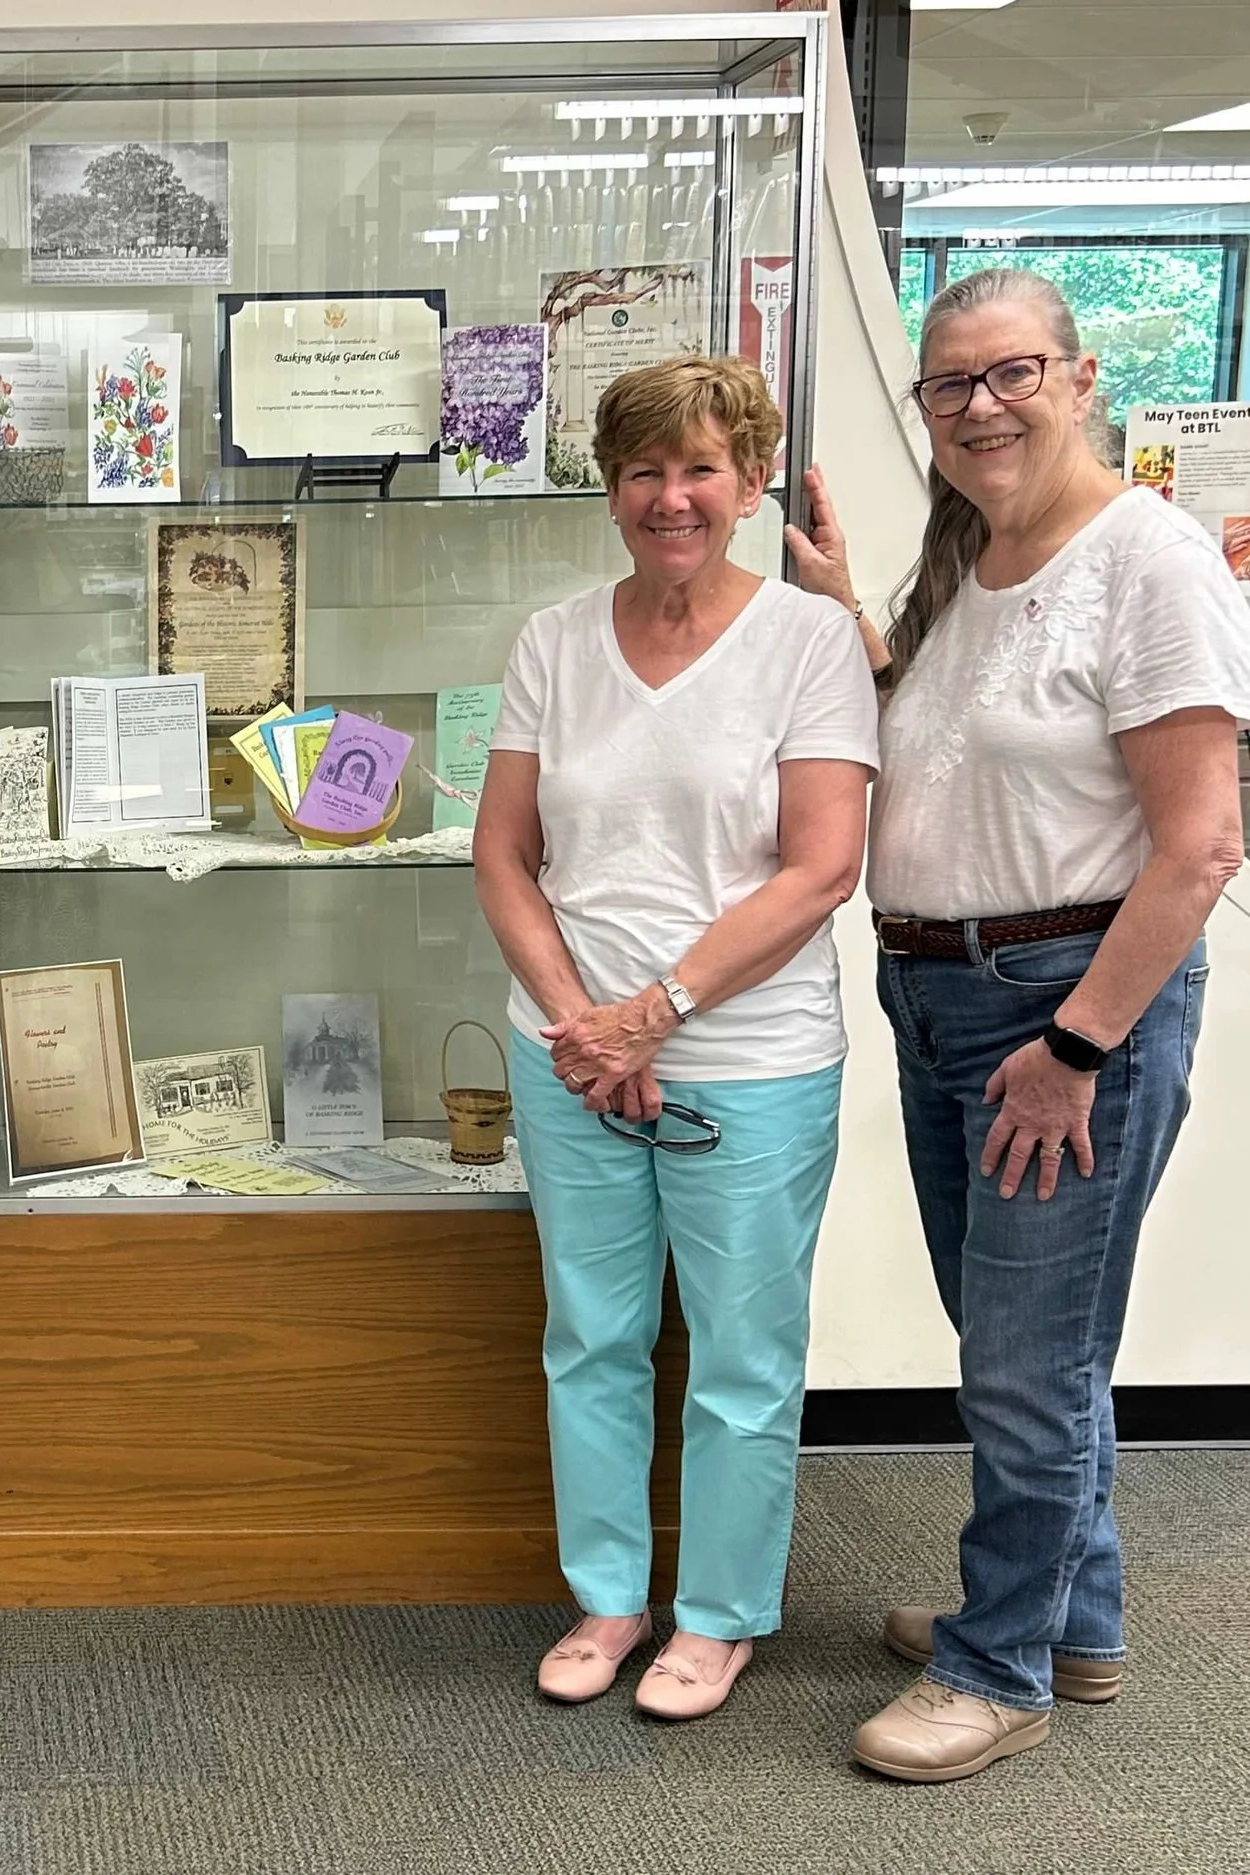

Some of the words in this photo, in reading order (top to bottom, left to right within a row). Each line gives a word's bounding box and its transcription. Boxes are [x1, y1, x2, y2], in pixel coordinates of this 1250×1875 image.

[755, 283, 790, 300] FIRE
[274, 352, 312, 364] Basking
[314, 352, 340, 364] Ridge
[343, 351, 376, 364] Garden
[378, 350, 401, 361] Club
[765, 307, 776, 393] EXTINGUI
[1144, 411, 1173, 424] May
[1176, 410, 1209, 421] Teen
[1181, 423, 1195, 434] at
[1198, 422, 1221, 434] BTL
[53, 1026, 66, 1035] and
